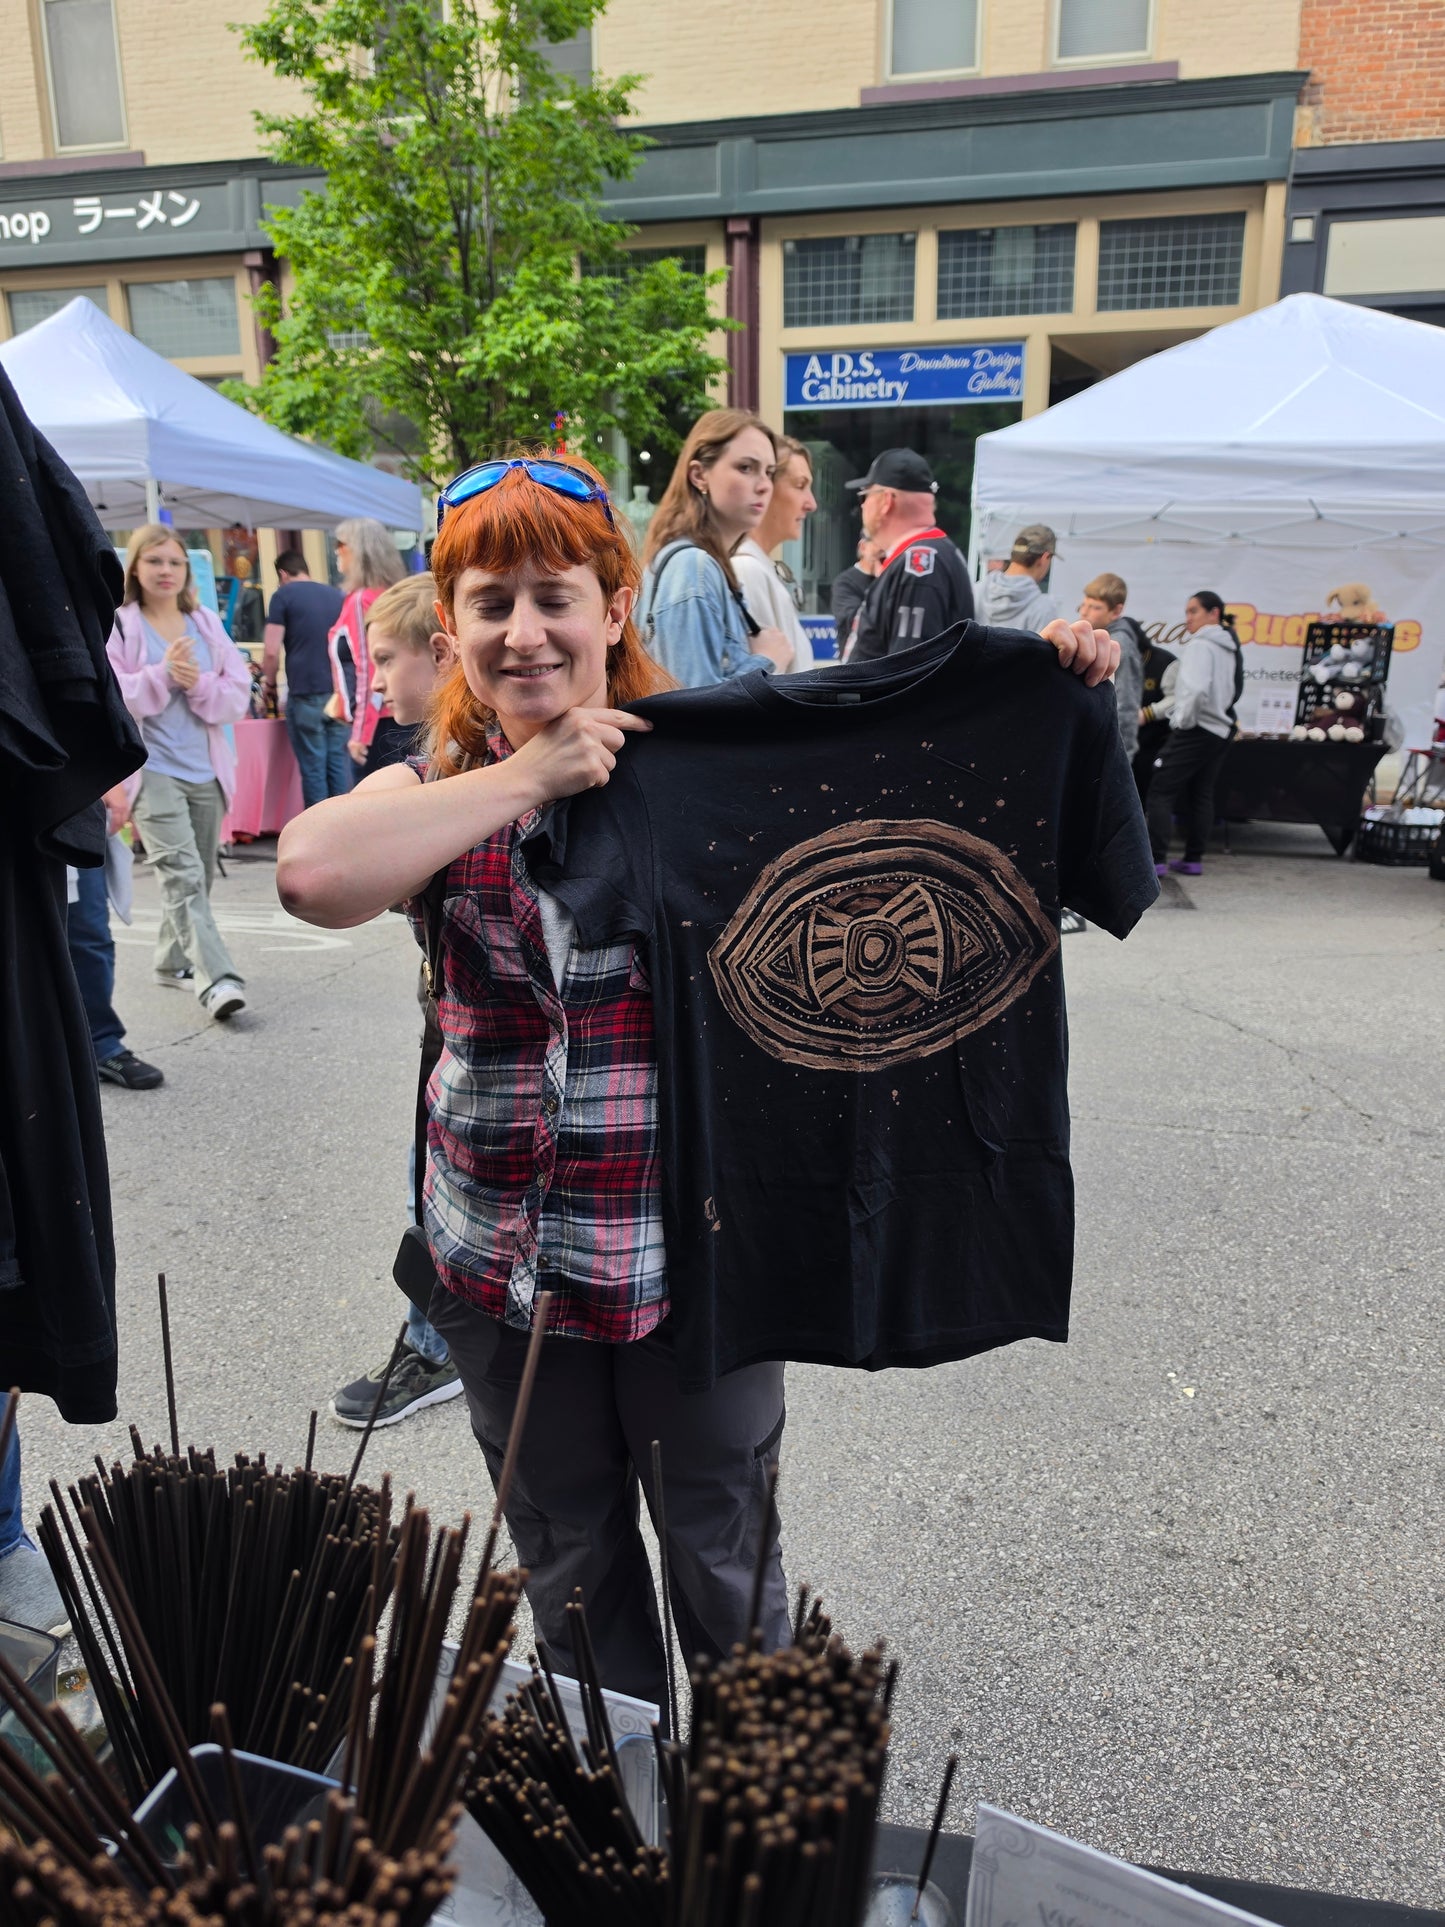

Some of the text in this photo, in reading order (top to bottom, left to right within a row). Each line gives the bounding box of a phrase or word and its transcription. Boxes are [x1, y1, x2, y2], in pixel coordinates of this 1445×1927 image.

[73, 190, 201, 234] ラーメン
[803, 352, 882, 379] A.D.S.
[898, 349, 1022, 374] Downtown Design
[801, 377, 909, 406] Cabinetry
[967, 371, 1022, 395] Gallery
[898, 605, 926, 639] 11
